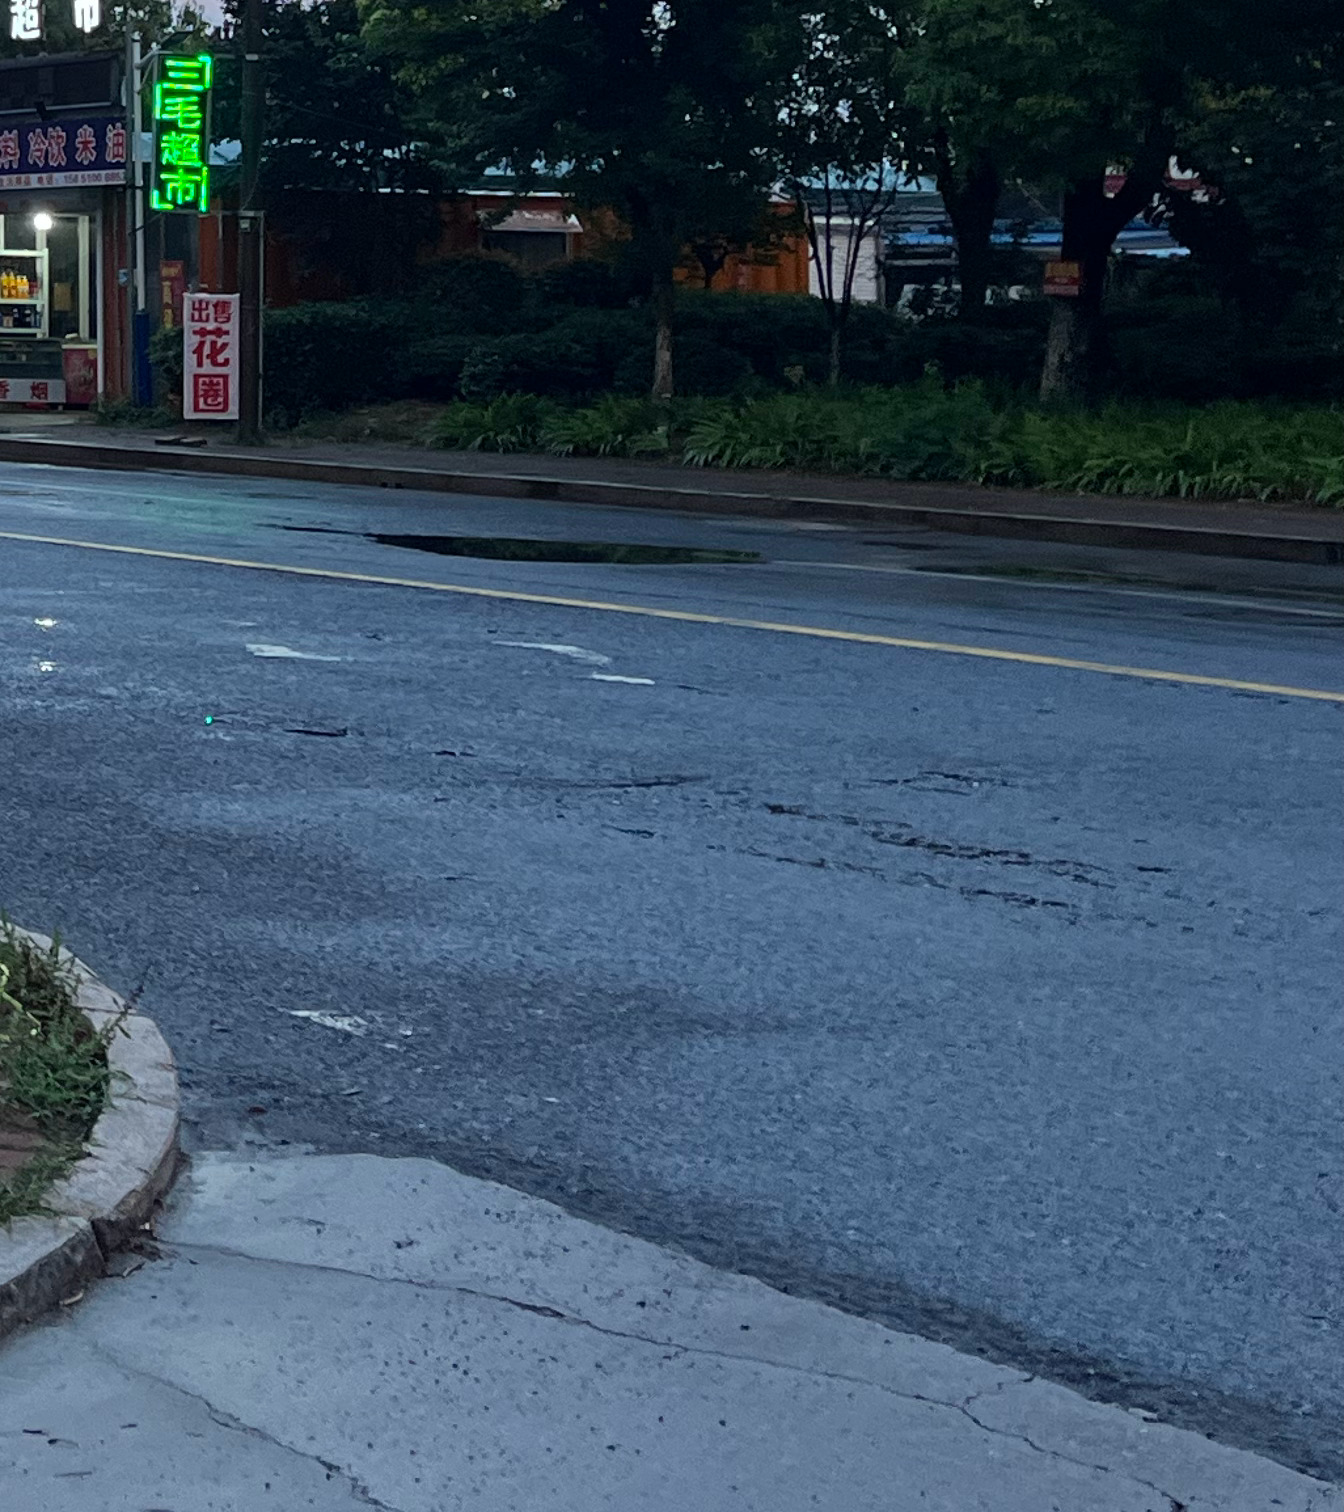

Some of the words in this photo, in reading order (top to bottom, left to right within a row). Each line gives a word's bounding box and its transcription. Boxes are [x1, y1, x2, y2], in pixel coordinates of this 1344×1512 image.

[28, 125, 67, 167] 冷饮
[75, 124, 97, 165] 米
[105, 121, 126, 164] 油
[160, 59, 204, 205] 三毛超市
[191, 299, 232, 323] 出售
[192, 327, 230, 413] 花圈
